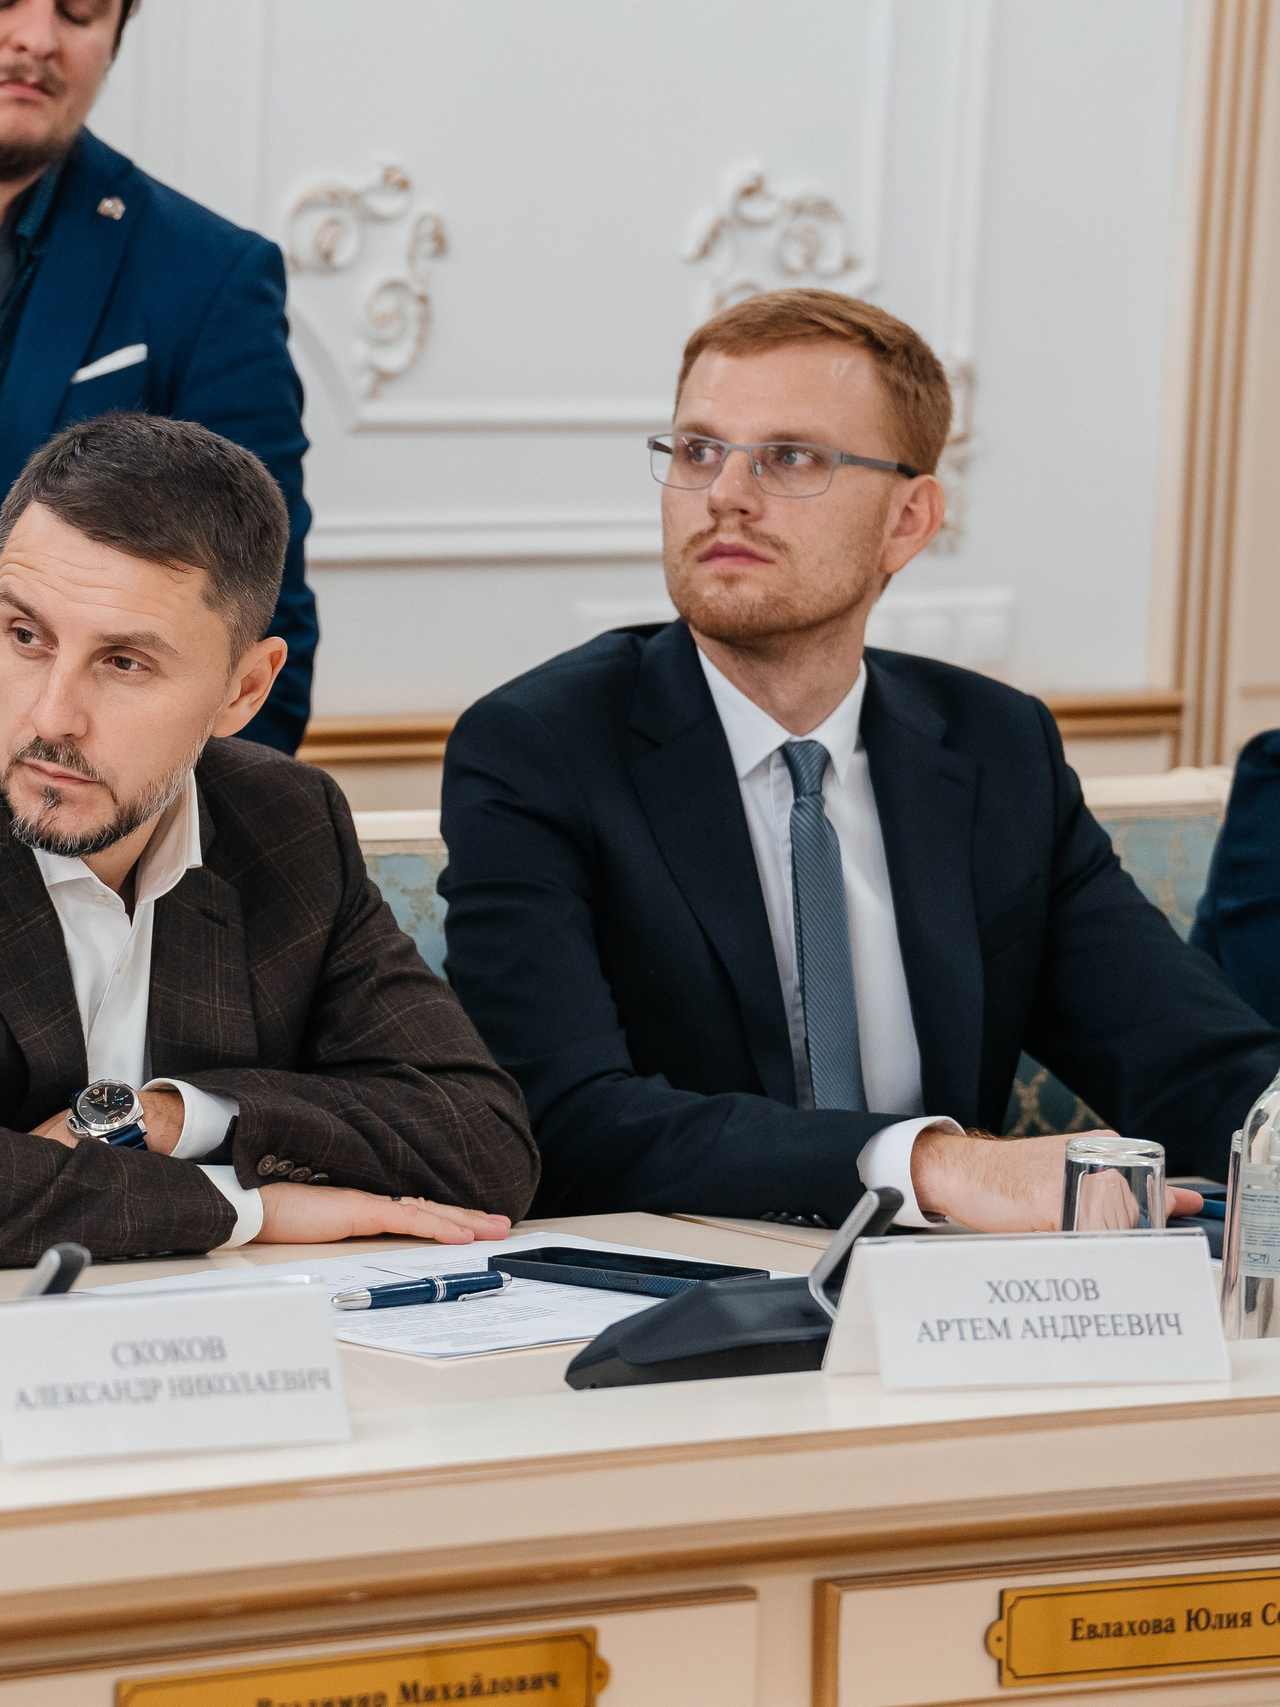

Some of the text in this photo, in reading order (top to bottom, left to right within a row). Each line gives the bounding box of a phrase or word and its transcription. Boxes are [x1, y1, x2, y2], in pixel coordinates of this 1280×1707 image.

[986, 1278, 1100, 1303] ХОХЛОВ
[917, 1312, 1183, 1342] АРТЕМ АНДРЕЕВИЧ
[111, 1335, 227, 1368] СКОКОВ
[13, 1367, 332, 1409] АЛЕКСАНДР НИКОЛАЕВИЧ
[1070, 1616, 1176, 1642] Евлахова
[1185, 1607, 1253, 1632] Юлия
[399, 1671, 560, 1703] Михайлович
